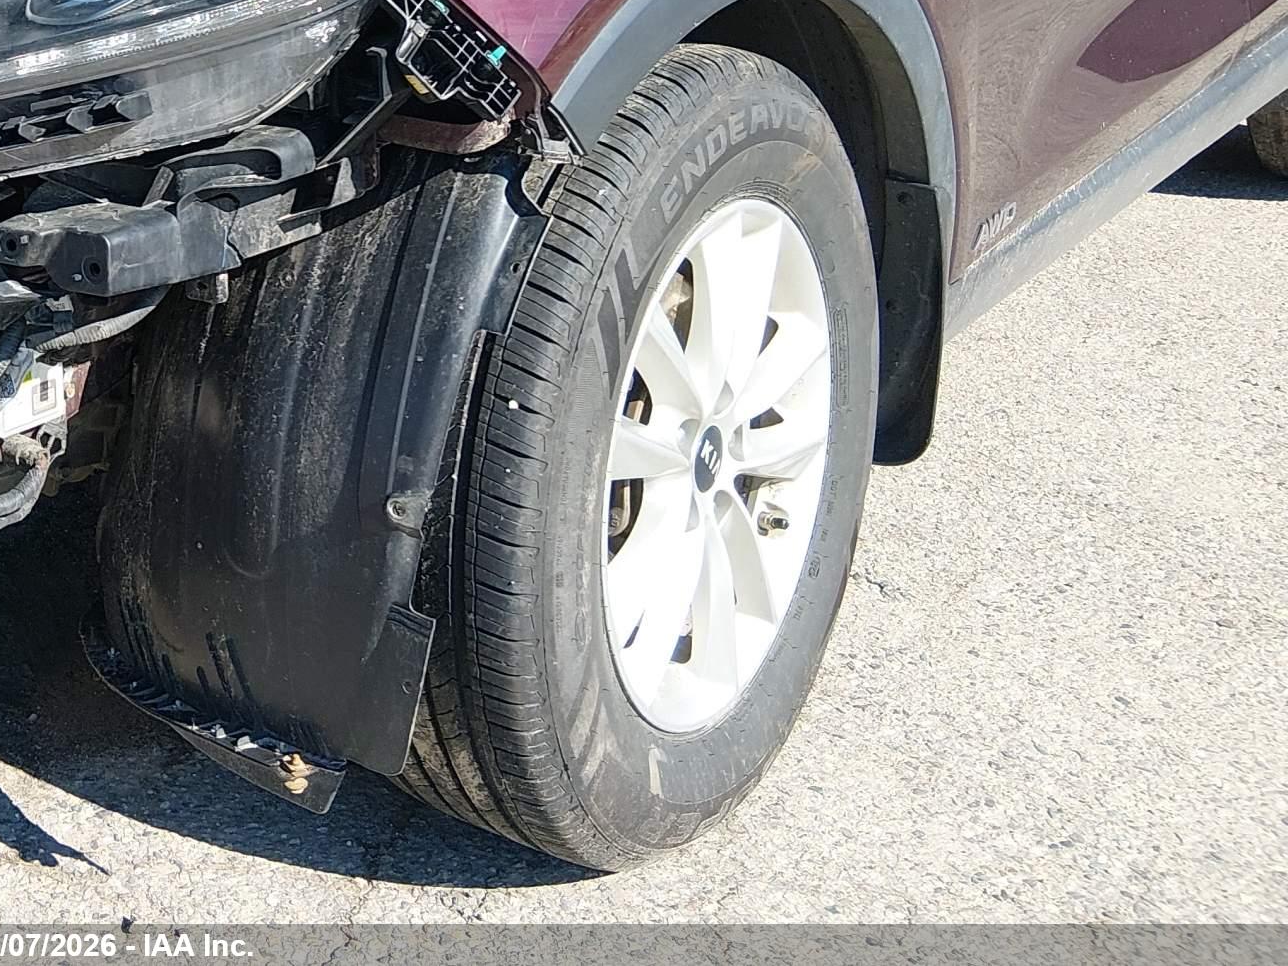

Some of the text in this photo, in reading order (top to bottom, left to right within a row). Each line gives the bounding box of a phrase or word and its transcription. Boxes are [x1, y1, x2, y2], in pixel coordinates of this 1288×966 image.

[658, 99, 827, 225] ENDEAVOR
[970, 201, 1017, 251] AWD
[700, 438, 721, 482] KIA
